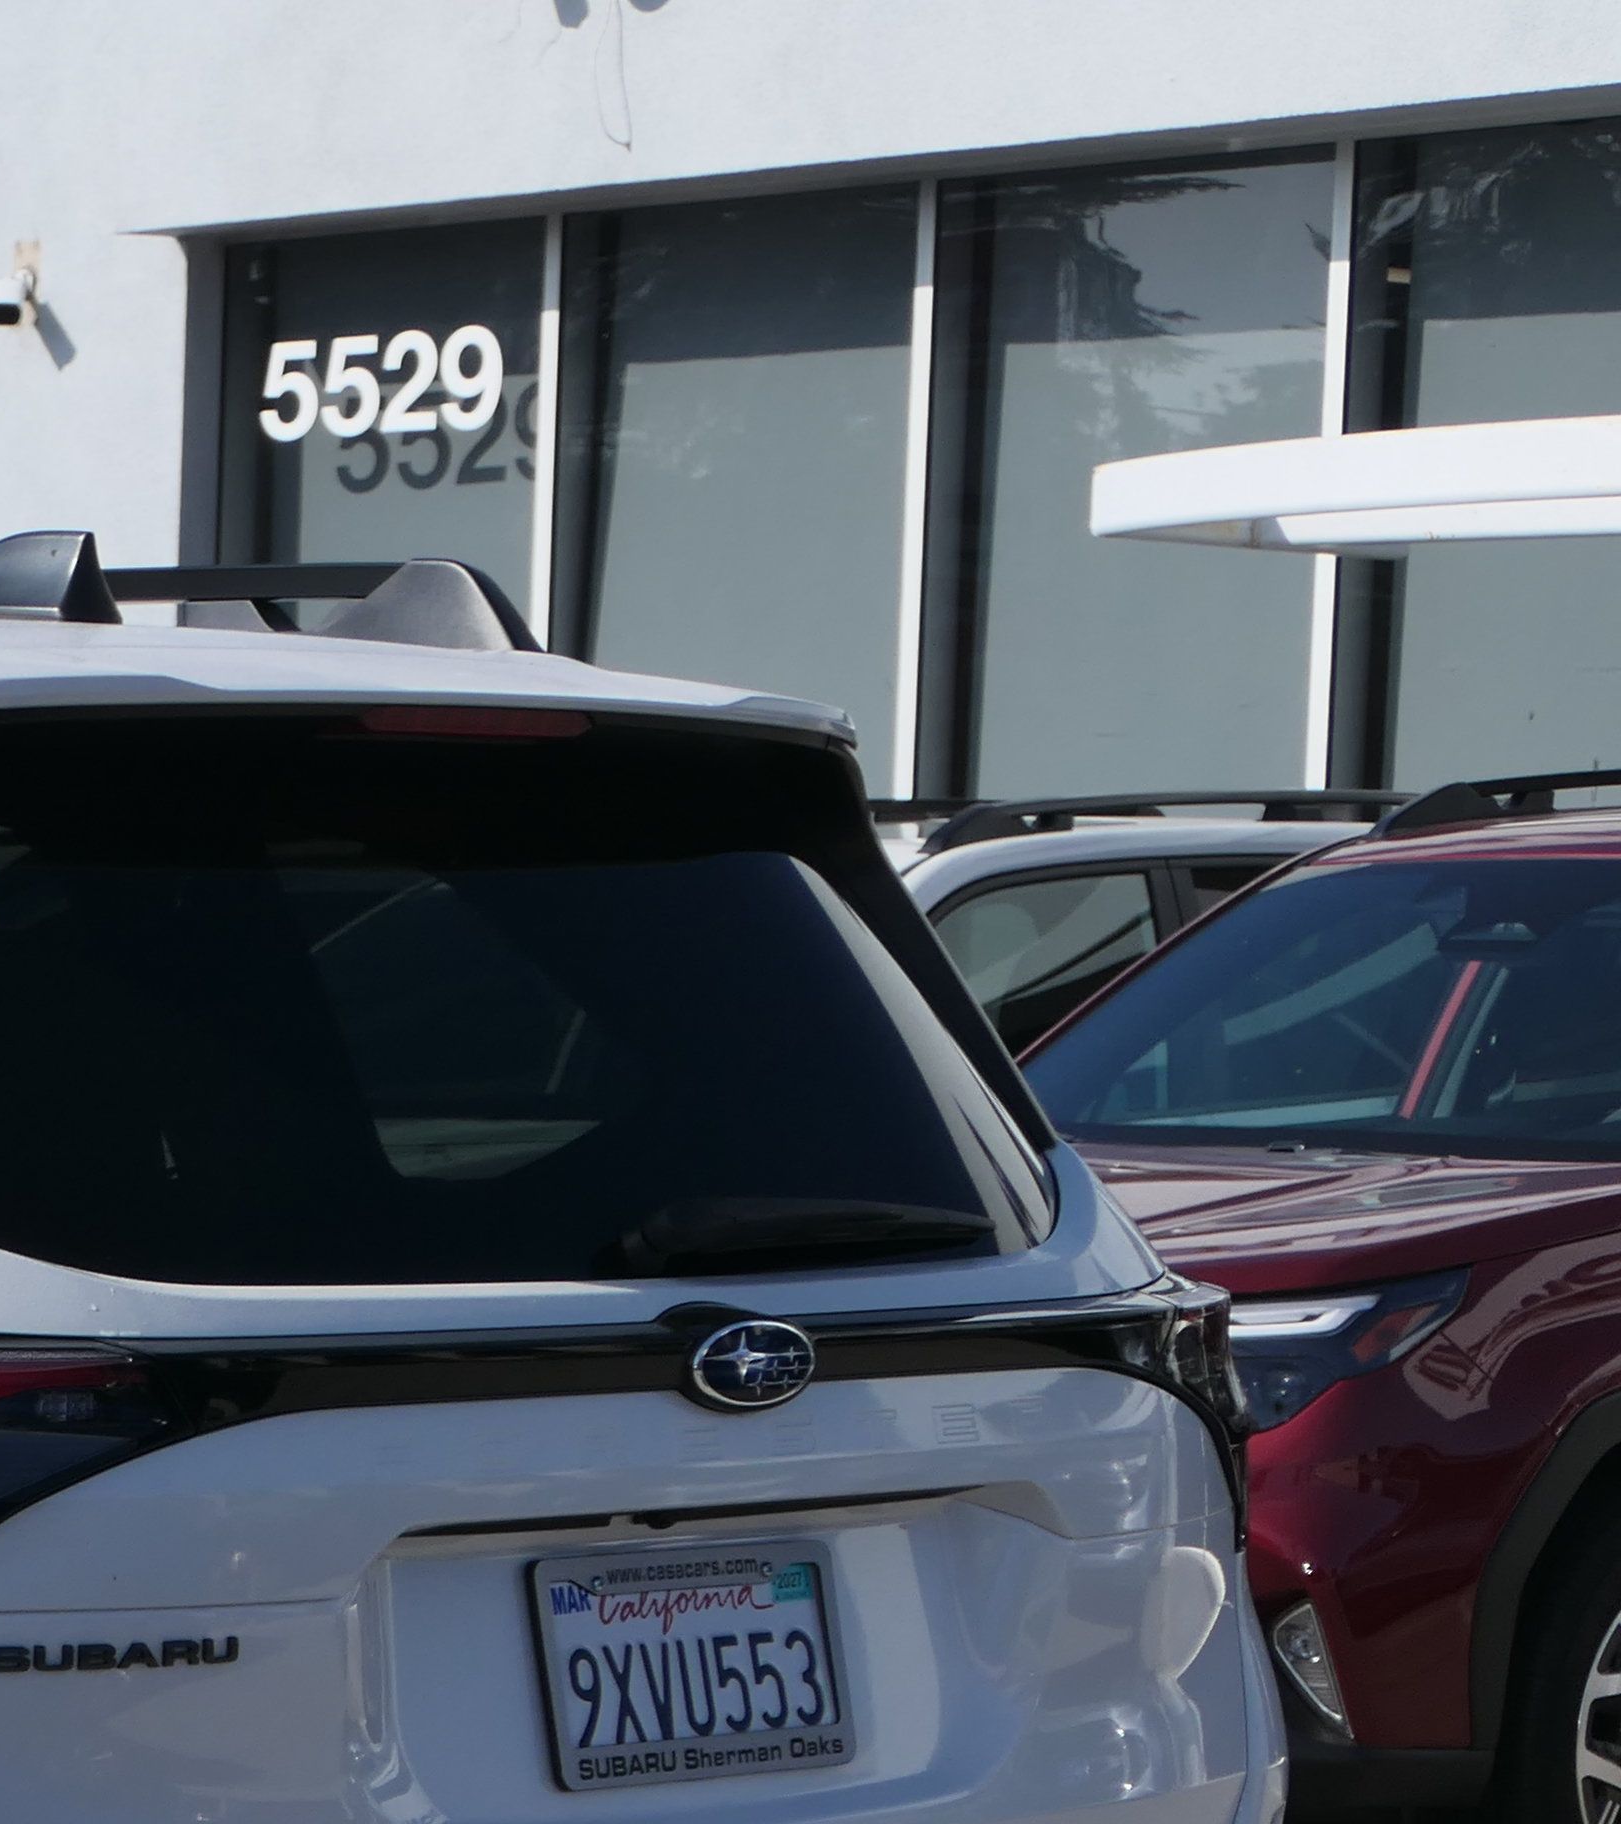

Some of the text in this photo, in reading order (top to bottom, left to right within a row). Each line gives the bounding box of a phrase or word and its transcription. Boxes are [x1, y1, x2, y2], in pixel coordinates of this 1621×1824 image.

[258, 324, 503, 442] 5529
[606, 1559, 758, 1583] www.casacars.com
[551, 1584, 592, 1616] MAR
[598, 1584, 773, 1634] California
[568, 1629, 825, 1748] 9XVU553
[579, 1735, 844, 1780] SUBARU Sherman Oaks
